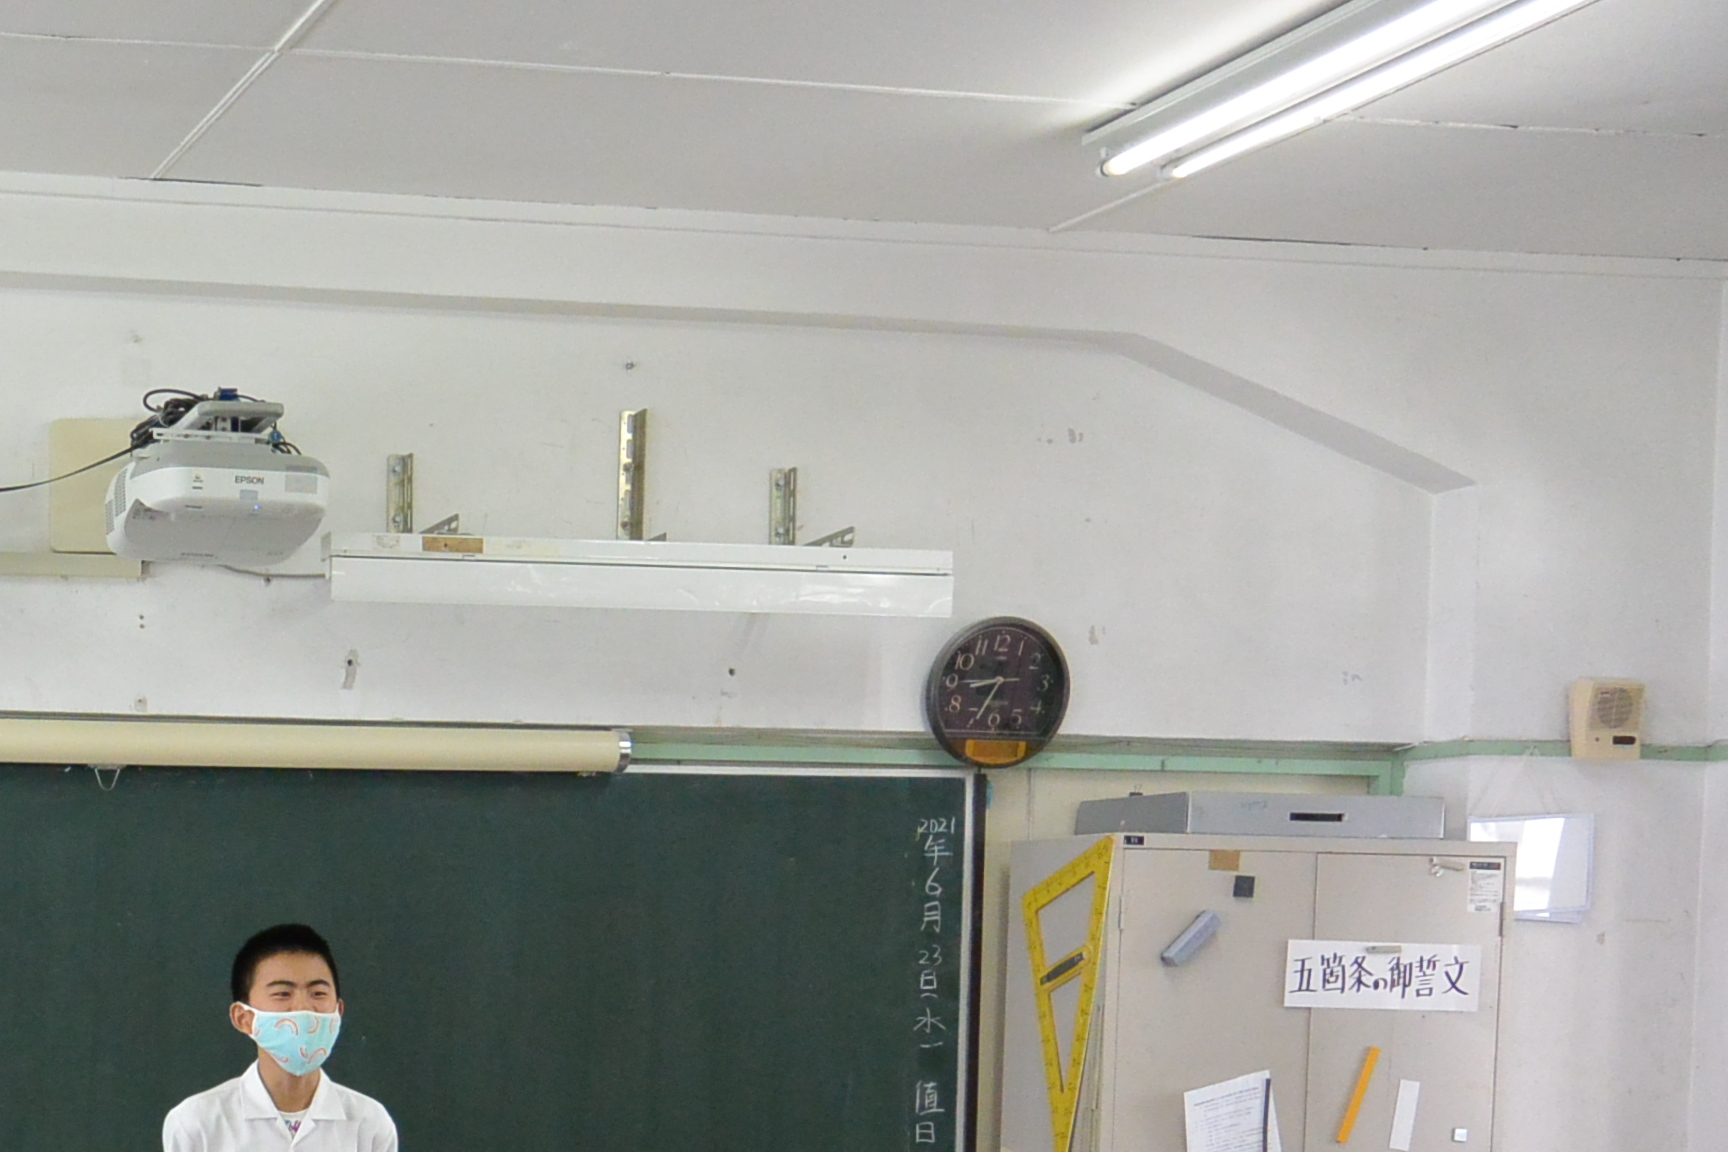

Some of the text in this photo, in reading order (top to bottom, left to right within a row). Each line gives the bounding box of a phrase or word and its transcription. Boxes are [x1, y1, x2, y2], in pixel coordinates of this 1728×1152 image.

[234, 475, 265, 485] EPSON
[993, 635, 1011, 652] 12
[955, 653, 975, 671] 10
[1029, 652, 1041, 670] 2
[945, 673, 959, 693] 9
[1037, 674, 1050, 692] 3
[948, 694, 962, 713] 8
[988, 709, 1001, 728] 6
[1010, 709, 1022, 726] 5
[1288, 951, 1471, 1000] 五箇条の御誓文
